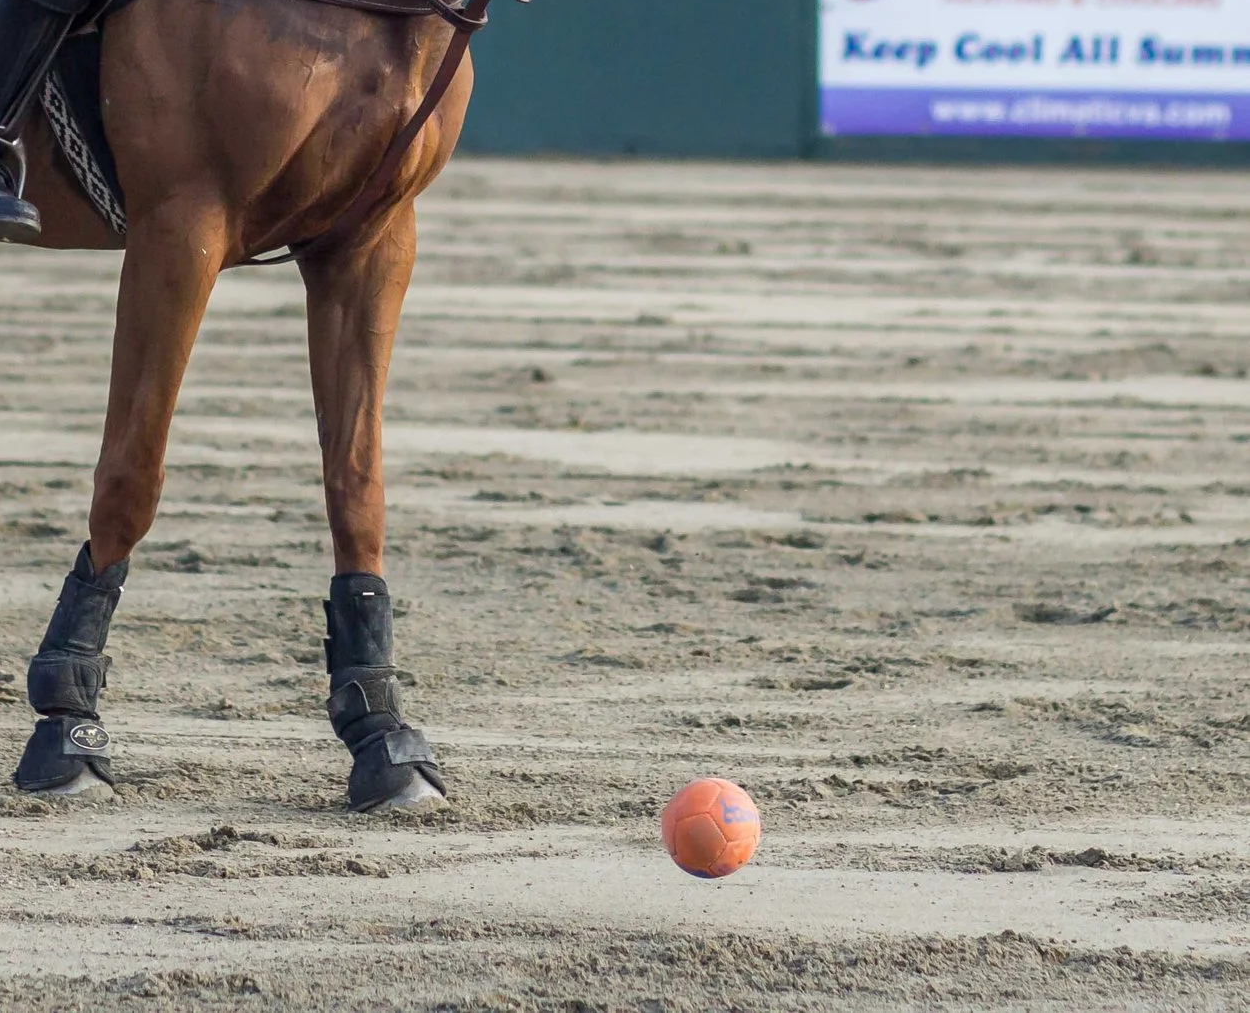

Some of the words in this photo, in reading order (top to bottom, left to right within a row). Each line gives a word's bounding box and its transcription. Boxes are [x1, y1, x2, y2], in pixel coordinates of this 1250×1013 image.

[842, 32, 938, 67] Keep
[954, 33, 1044, 63] Cool
[1061, 34, 1120, 64] All
